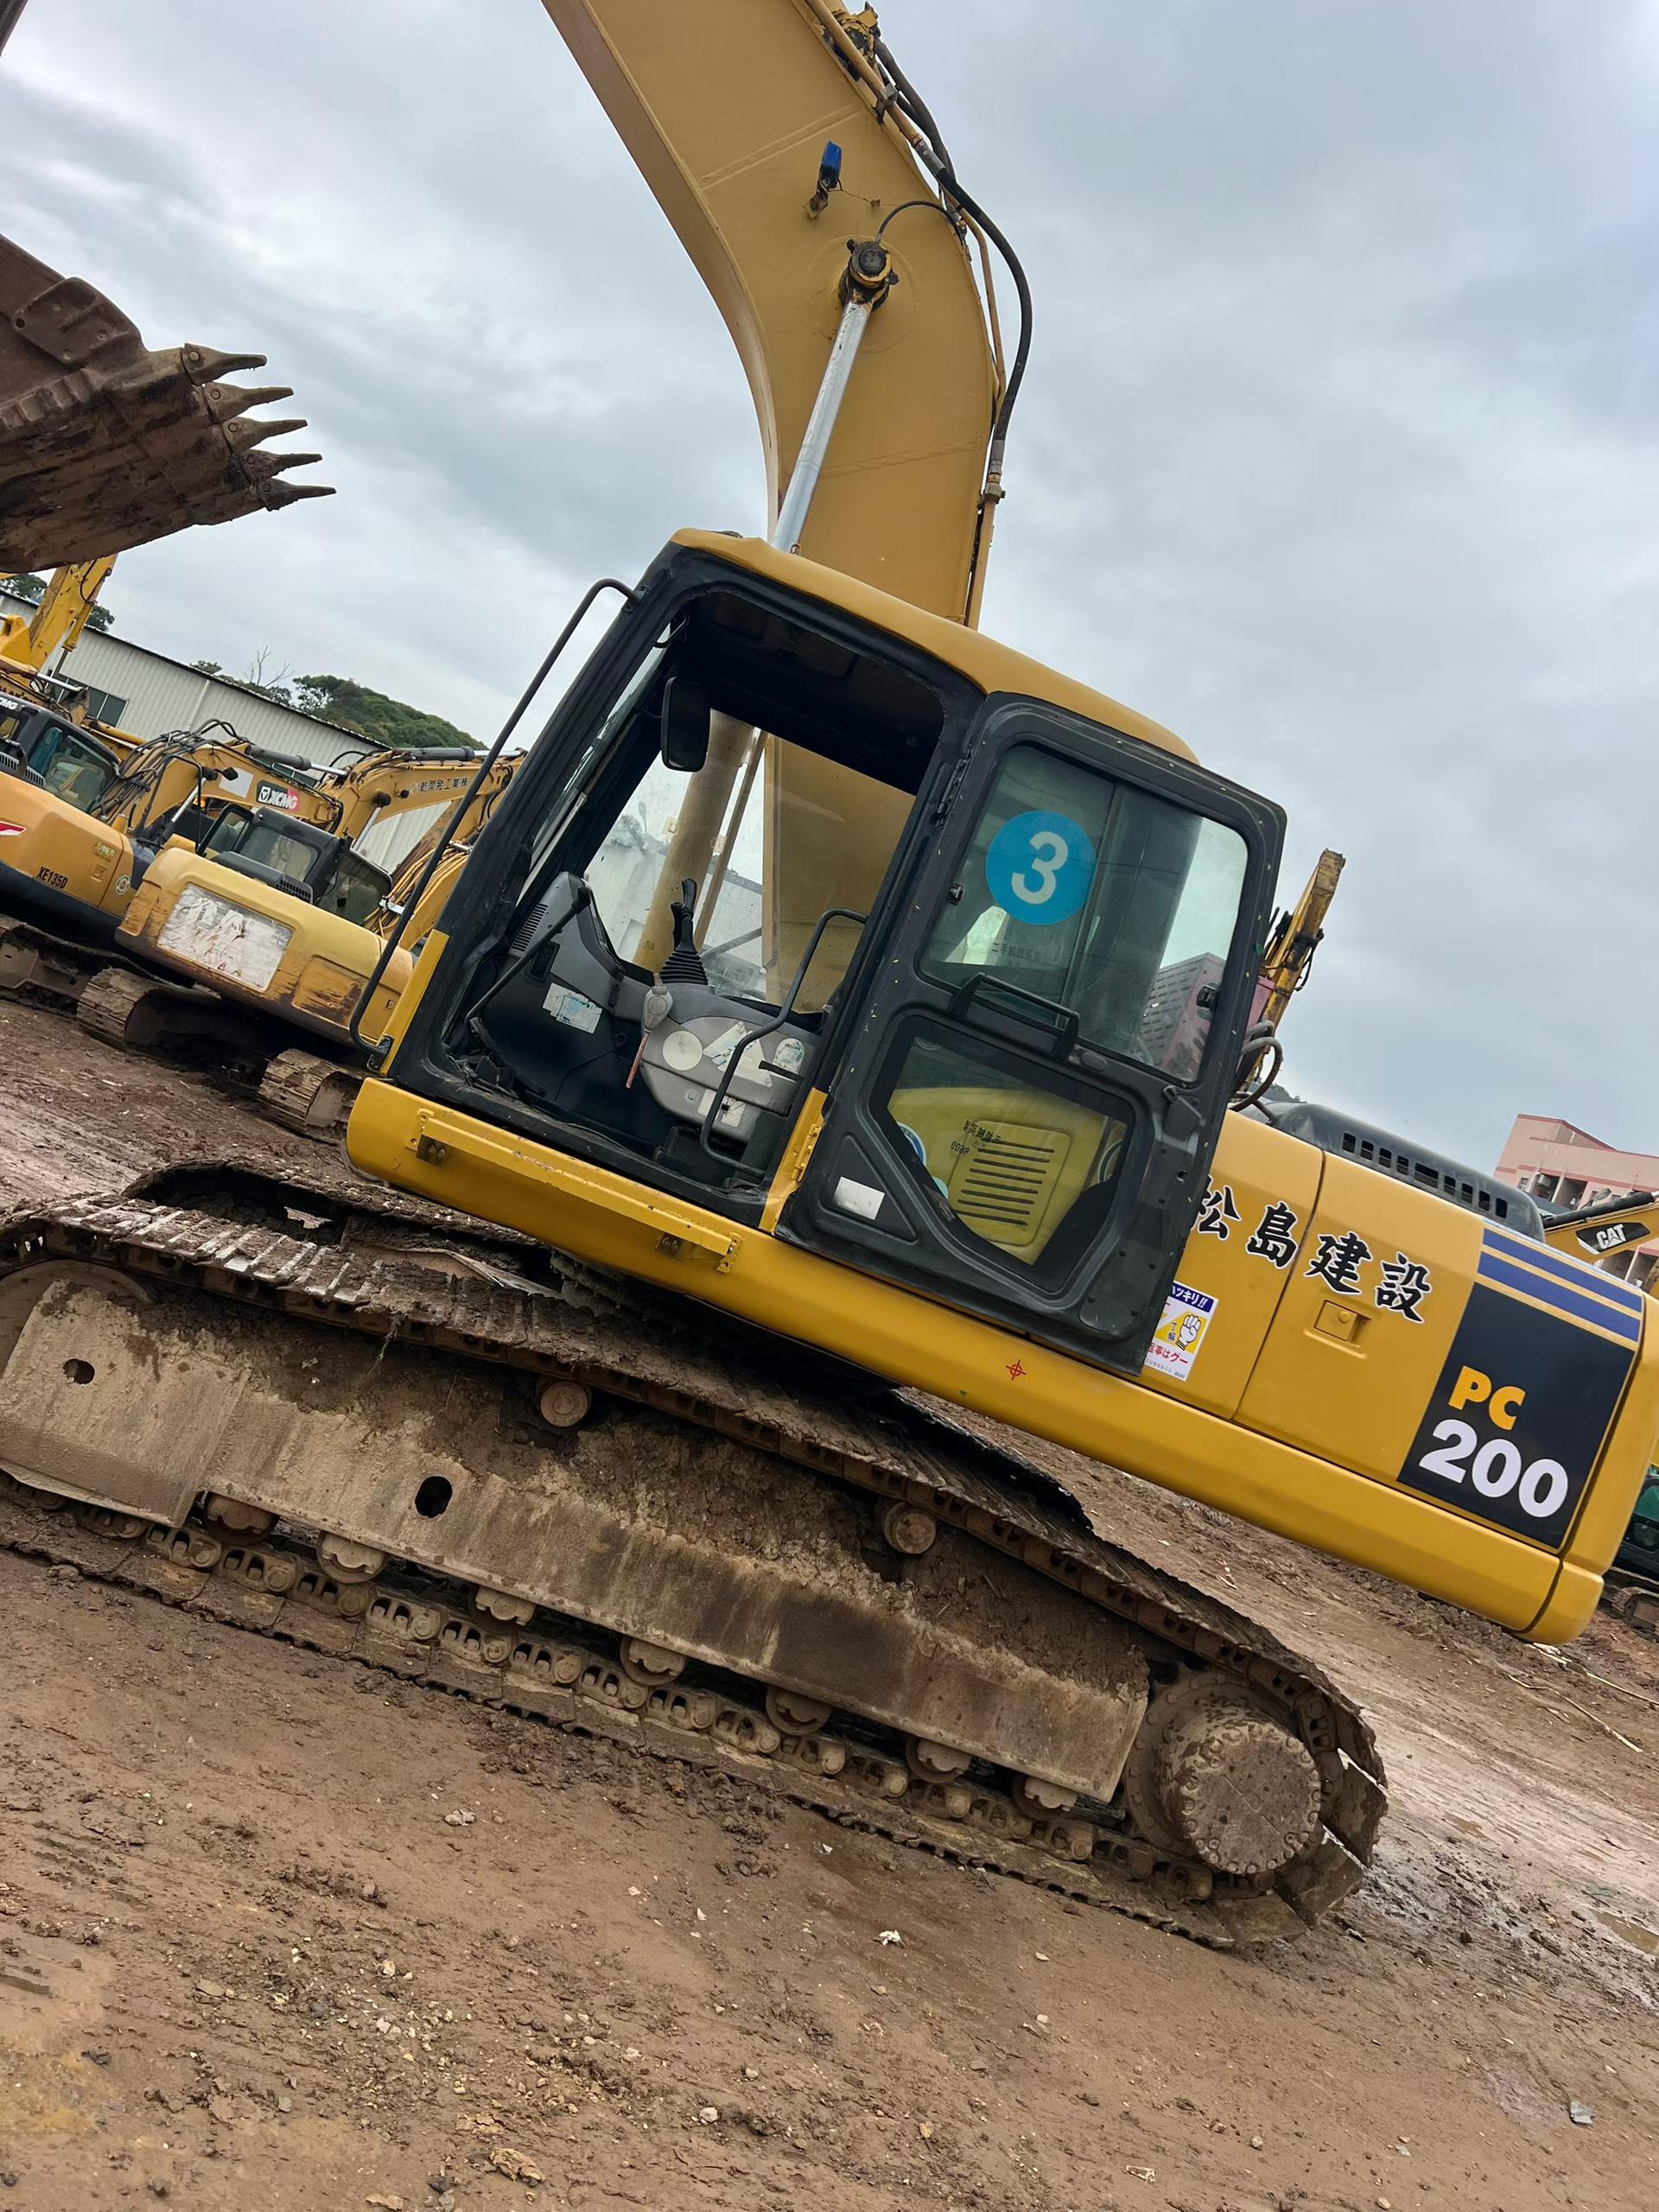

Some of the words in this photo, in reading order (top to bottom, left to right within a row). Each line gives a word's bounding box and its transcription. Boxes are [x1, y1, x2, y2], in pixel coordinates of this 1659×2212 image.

[270, 790, 298, 809] XCMG
[36, 866, 68, 889] XE135D
[1011, 830, 1068, 904] 3
[1192, 1175, 1431, 1323] 松島建設
[1596, 1224, 1626, 1249] CAT
[1448, 1365, 1526, 1431] PC
[1419, 1419, 1569, 1518] 200
